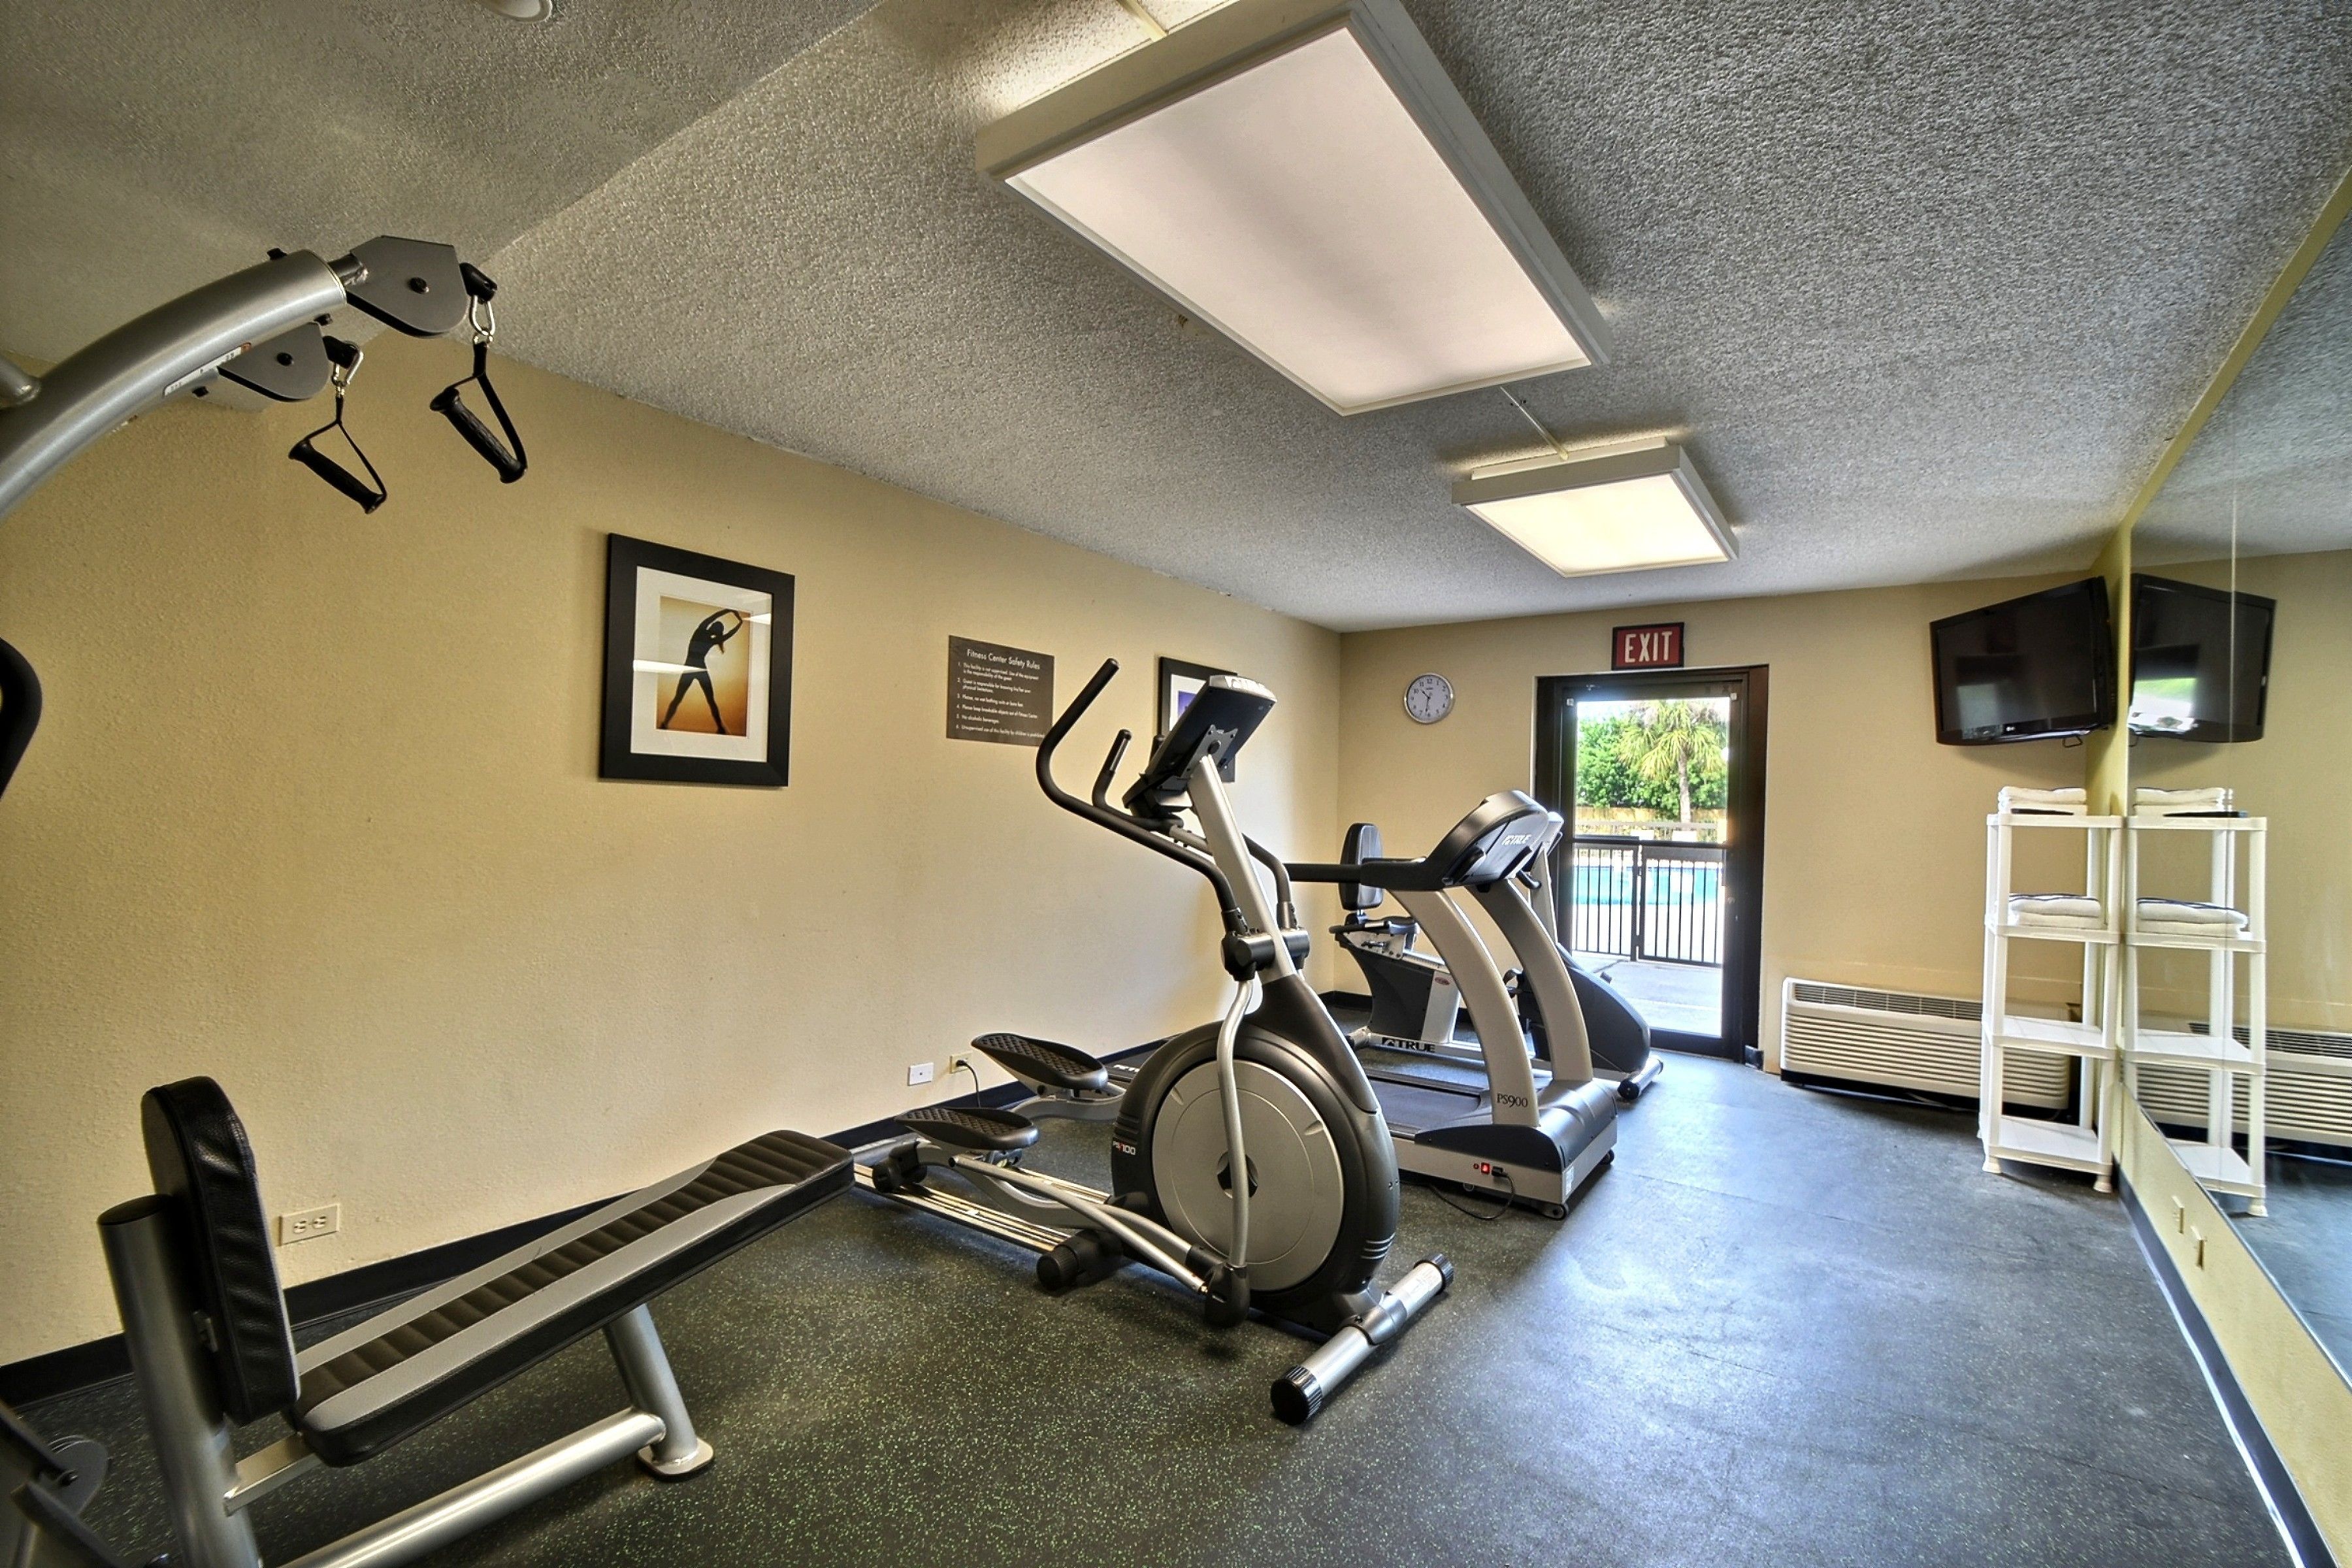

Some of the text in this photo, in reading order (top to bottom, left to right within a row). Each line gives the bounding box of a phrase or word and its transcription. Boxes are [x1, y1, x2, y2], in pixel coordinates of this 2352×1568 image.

[1625, 631, 1673, 663] EXIT
[967, 649, 987, 660] Fitness
[988, 653, 1007, 663] Center
[1008, 657, 1026, 669] Safety
[1026, 660, 1040, 670] Rules
[1396, 1038, 1436, 1053] TRUE
[1497, 1093, 1528, 1108] PS900
